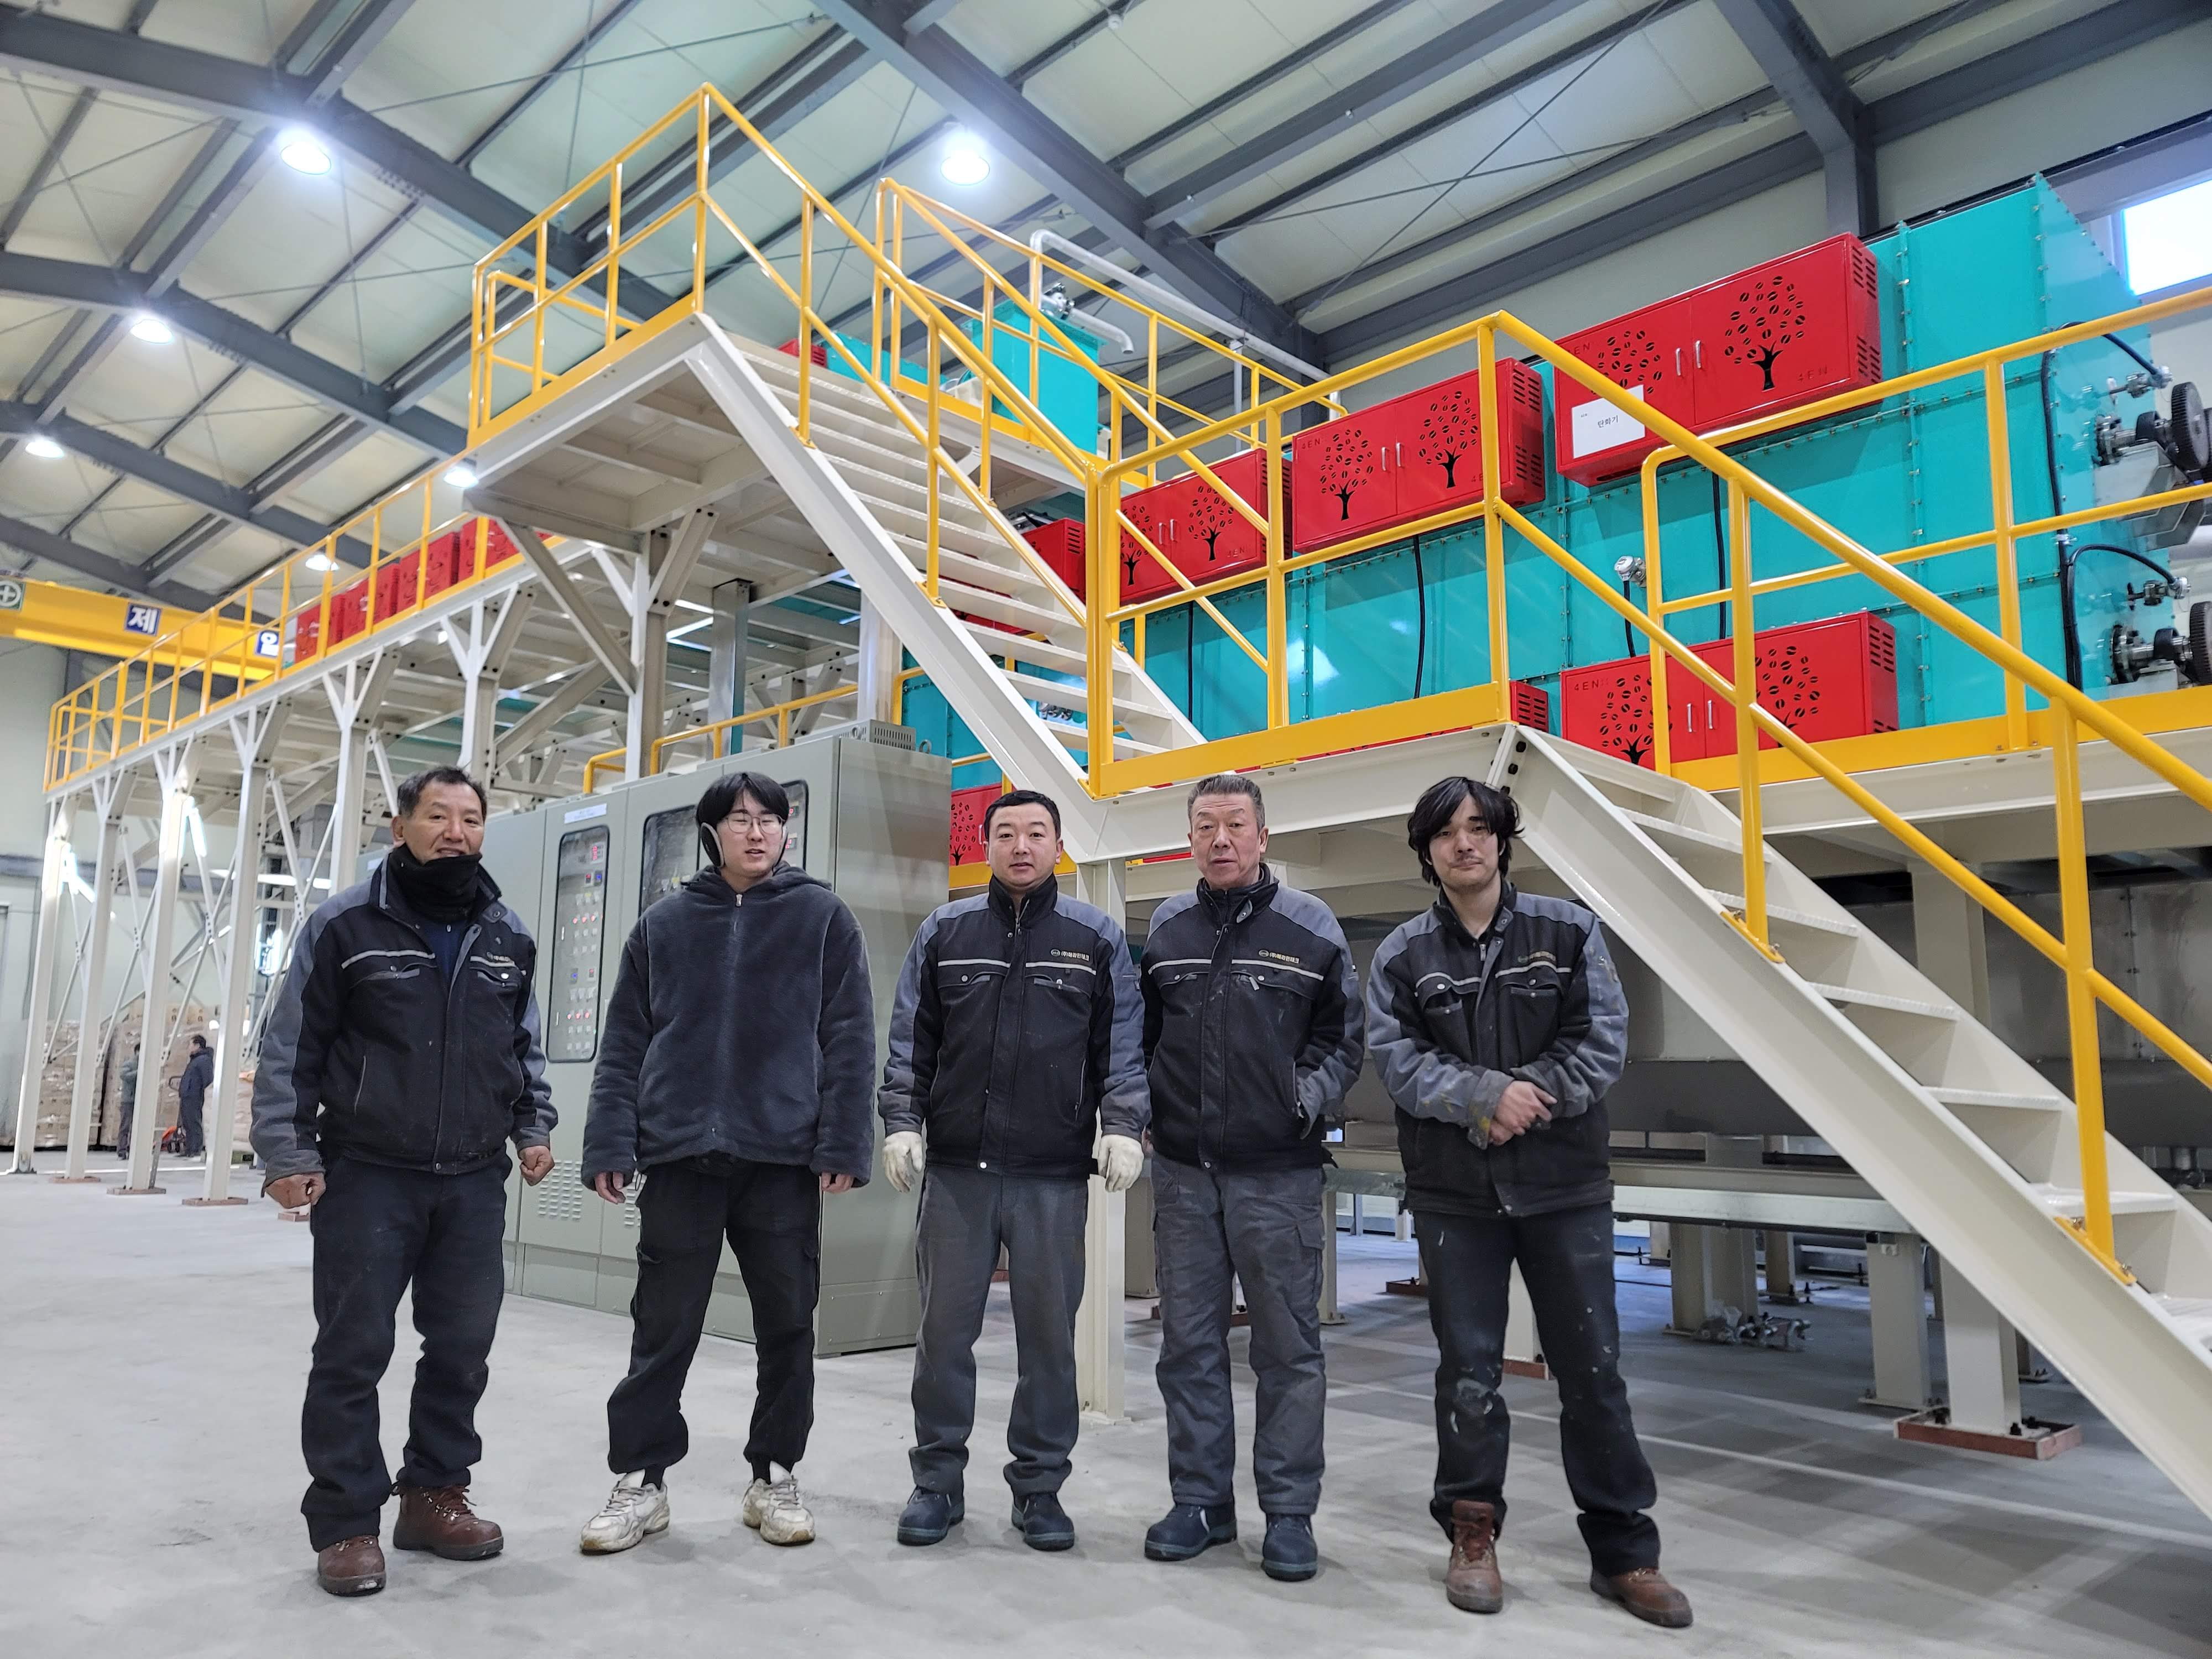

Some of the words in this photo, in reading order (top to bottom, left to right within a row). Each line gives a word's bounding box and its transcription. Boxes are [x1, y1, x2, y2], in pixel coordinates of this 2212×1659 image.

[1598, 415, 1618, 428] 탄화기
[128, 607, 158, 634] 제
[1574, 679, 1599, 691] 4EN
